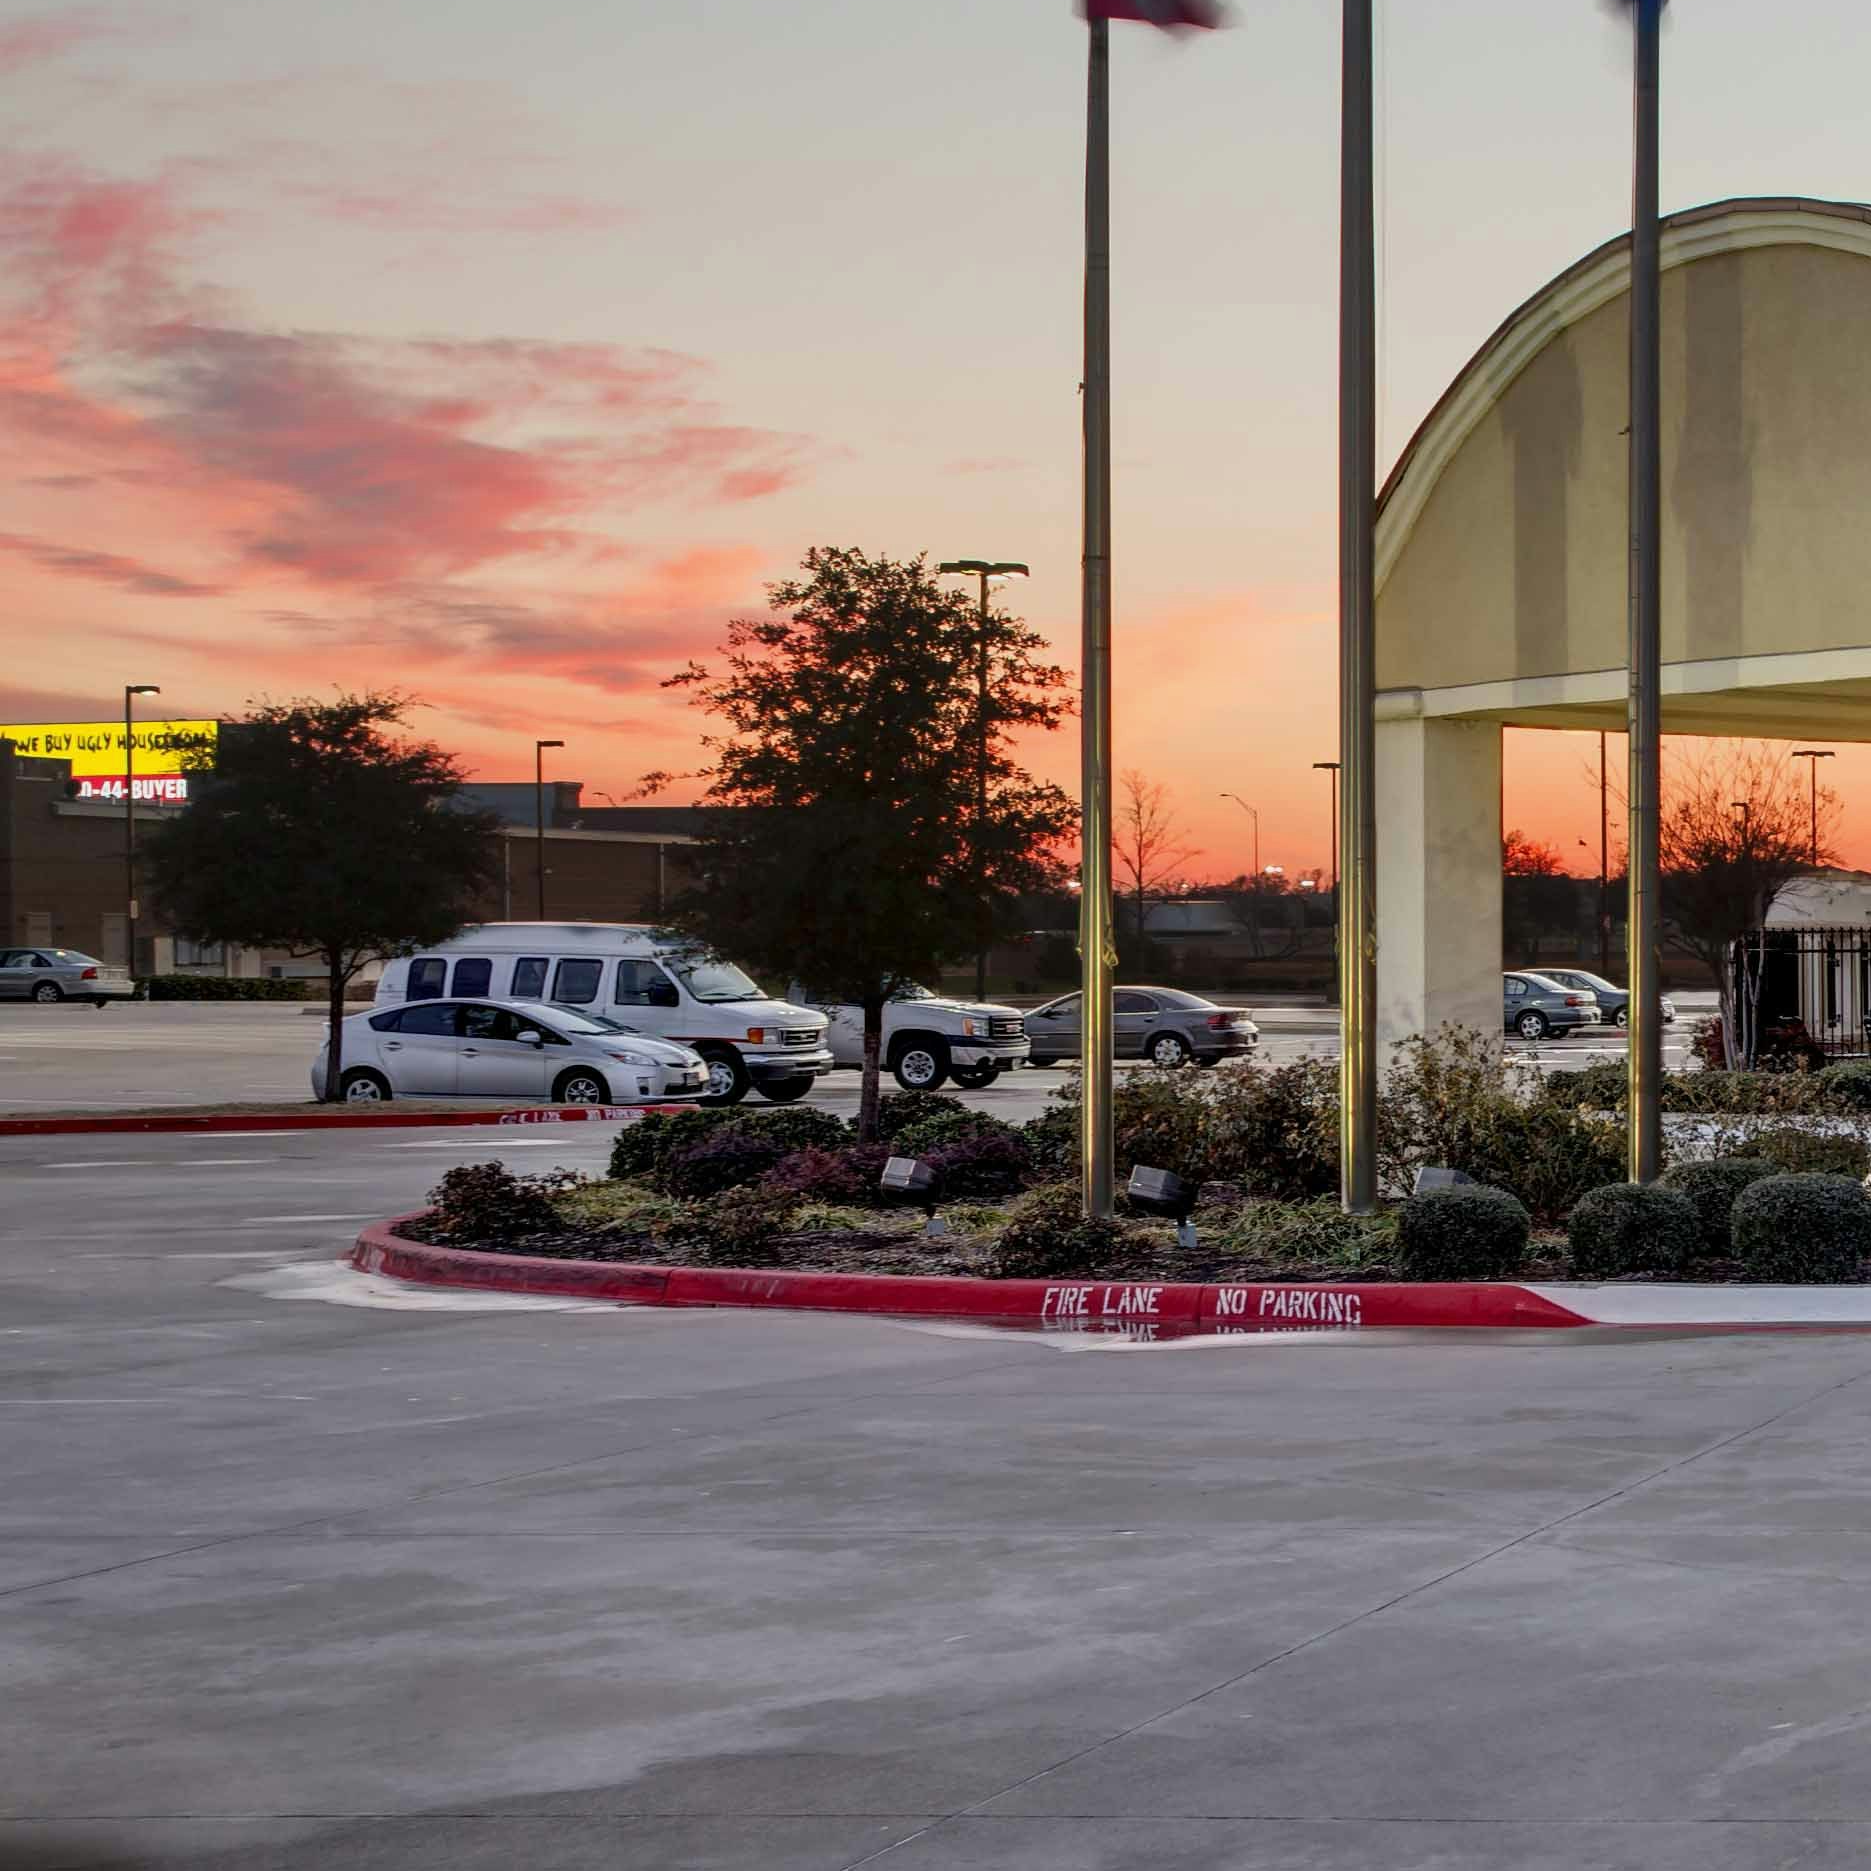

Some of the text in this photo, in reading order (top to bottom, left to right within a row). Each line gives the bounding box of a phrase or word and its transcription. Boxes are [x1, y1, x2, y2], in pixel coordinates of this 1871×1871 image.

[16, 736, 39, 753] WE
[45, 733, 73, 753] BUY
[77, 732, 111, 753] UGLY
[1042, 1286, 1362, 1325] FIRE LANE NO PARKING
